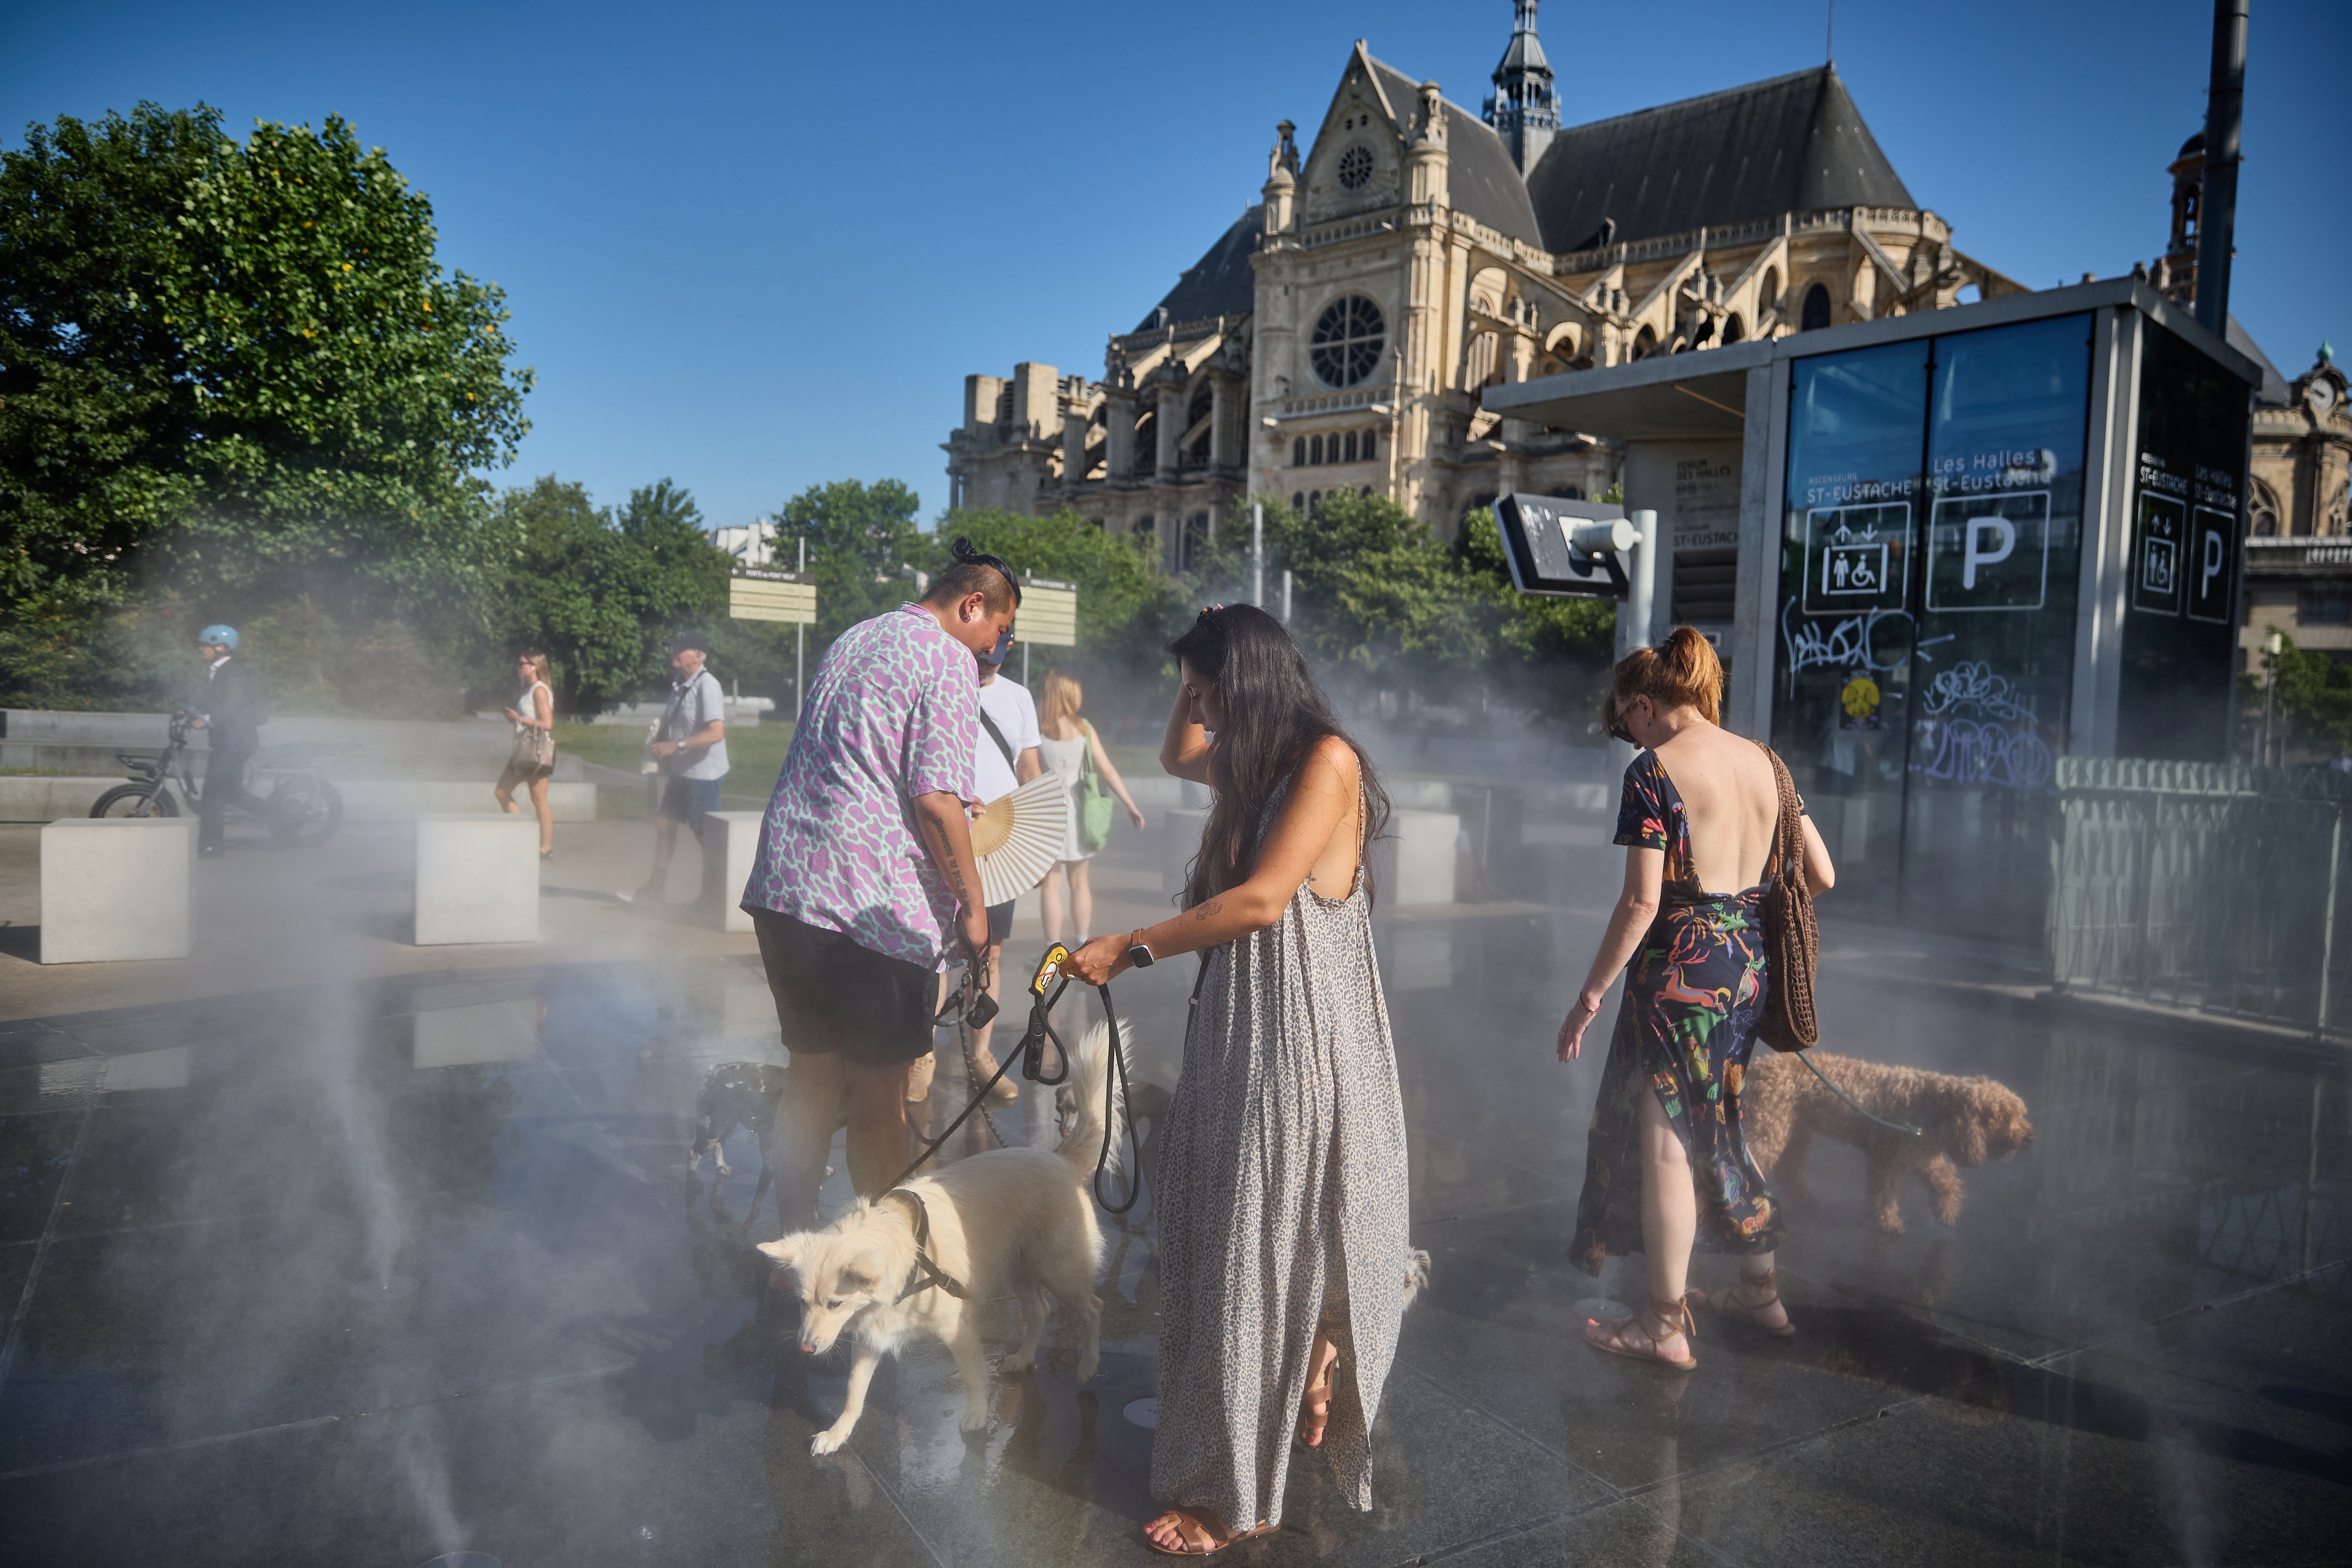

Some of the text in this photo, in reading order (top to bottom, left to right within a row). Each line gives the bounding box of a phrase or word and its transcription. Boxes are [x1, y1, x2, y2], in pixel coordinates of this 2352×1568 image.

[1934, 449, 2035, 474] Les Halles
[1808, 472, 1858, 484] ASCENSEURS
[1932, 469, 2051, 493] St-Eustache
[2140, 466, 2188, 495] ST-EUSTACHE
[1807, 479, 1912, 504] ST-EUSTACHE
[1673, 531, 1739, 547] ST-EUSTACH
[1963, 516, 2017, 590] P
[2201, 529, 2222, 600] P
[933, 817, 954, 857] Personne
[950, 859, 958, 869] ne
[952, 870, 965, 887] peut
[959, 888, 968, 899] me
